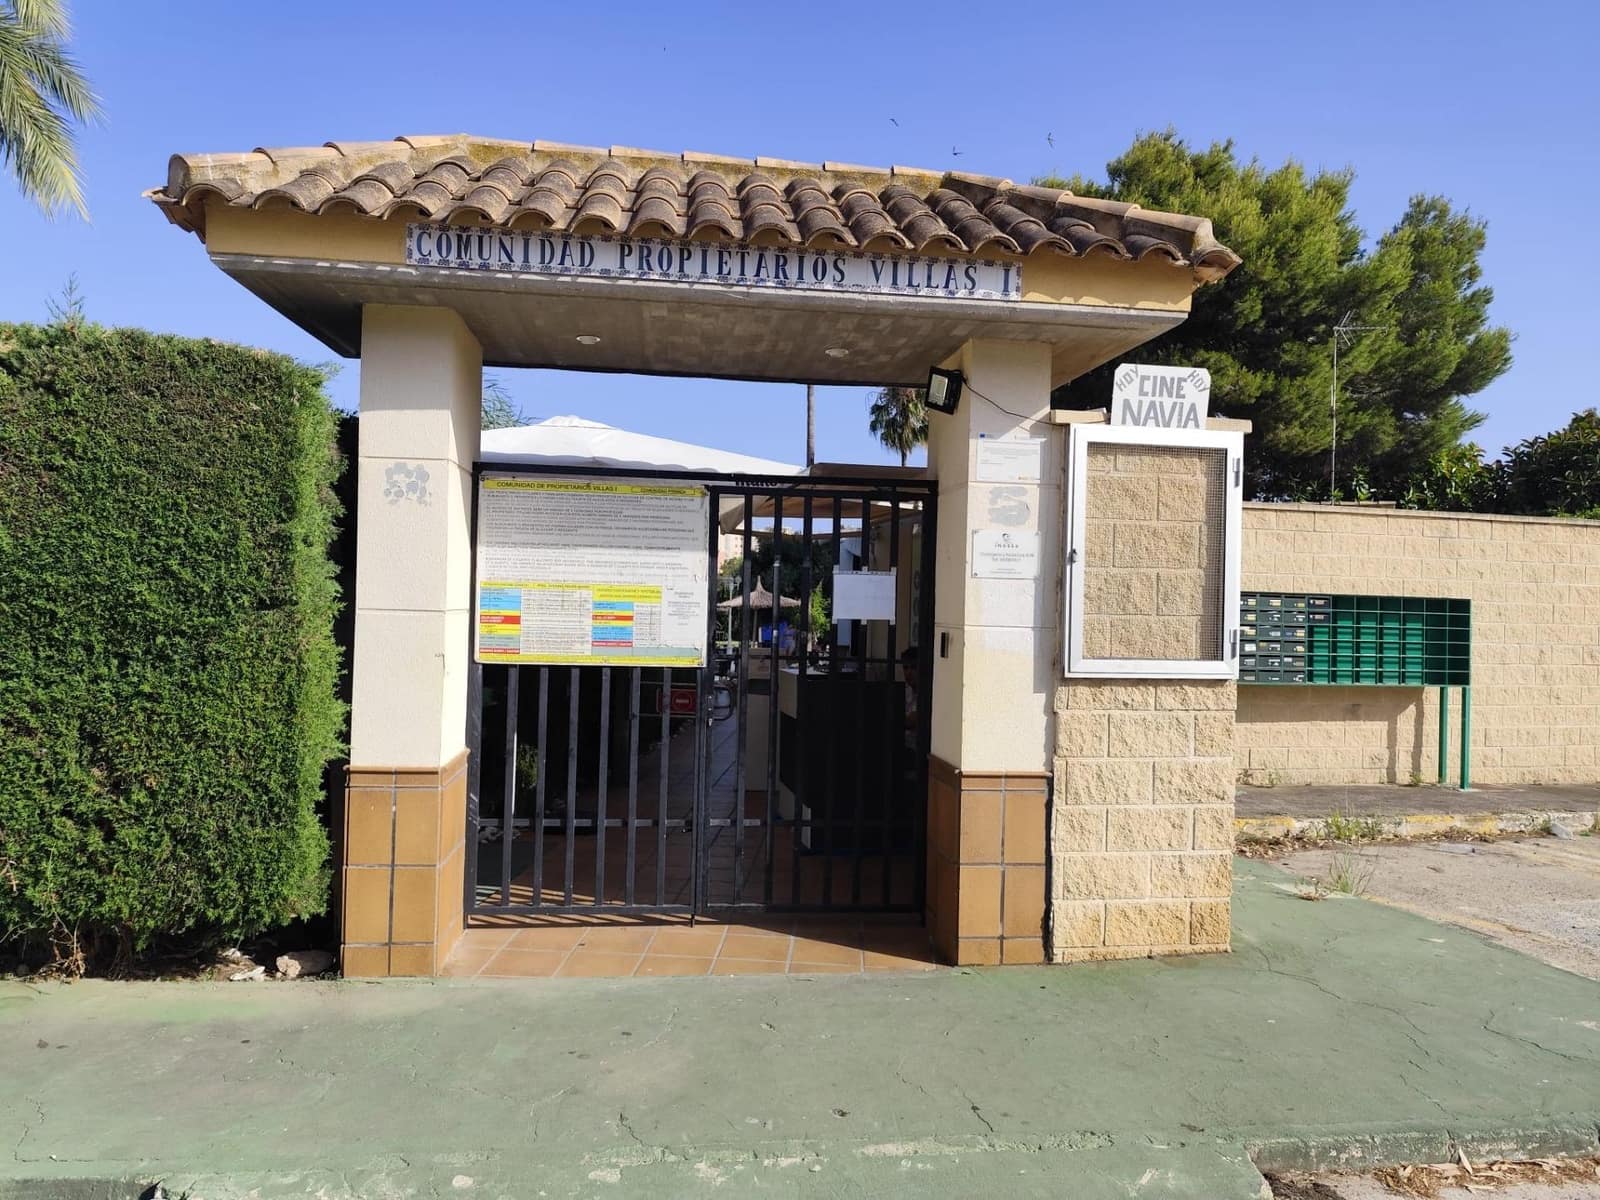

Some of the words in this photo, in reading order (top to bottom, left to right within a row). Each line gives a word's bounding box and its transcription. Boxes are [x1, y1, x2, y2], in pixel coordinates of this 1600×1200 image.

[416, 231, 595, 268] COMUNIDAD
[618, 243, 846, 283] PROPIETARIOS
[870, 260, 977, 290] VILLAS
[1002, 268, 1010, 292] I
[1115, 365, 1139, 392] HOY
[1138, 375, 1188, 399] CINE
[1187, 370, 1210, 393] HOY
[1121, 398, 1200, 429] NAVIA
[496, 481, 536, 489] COMUNIDAD
